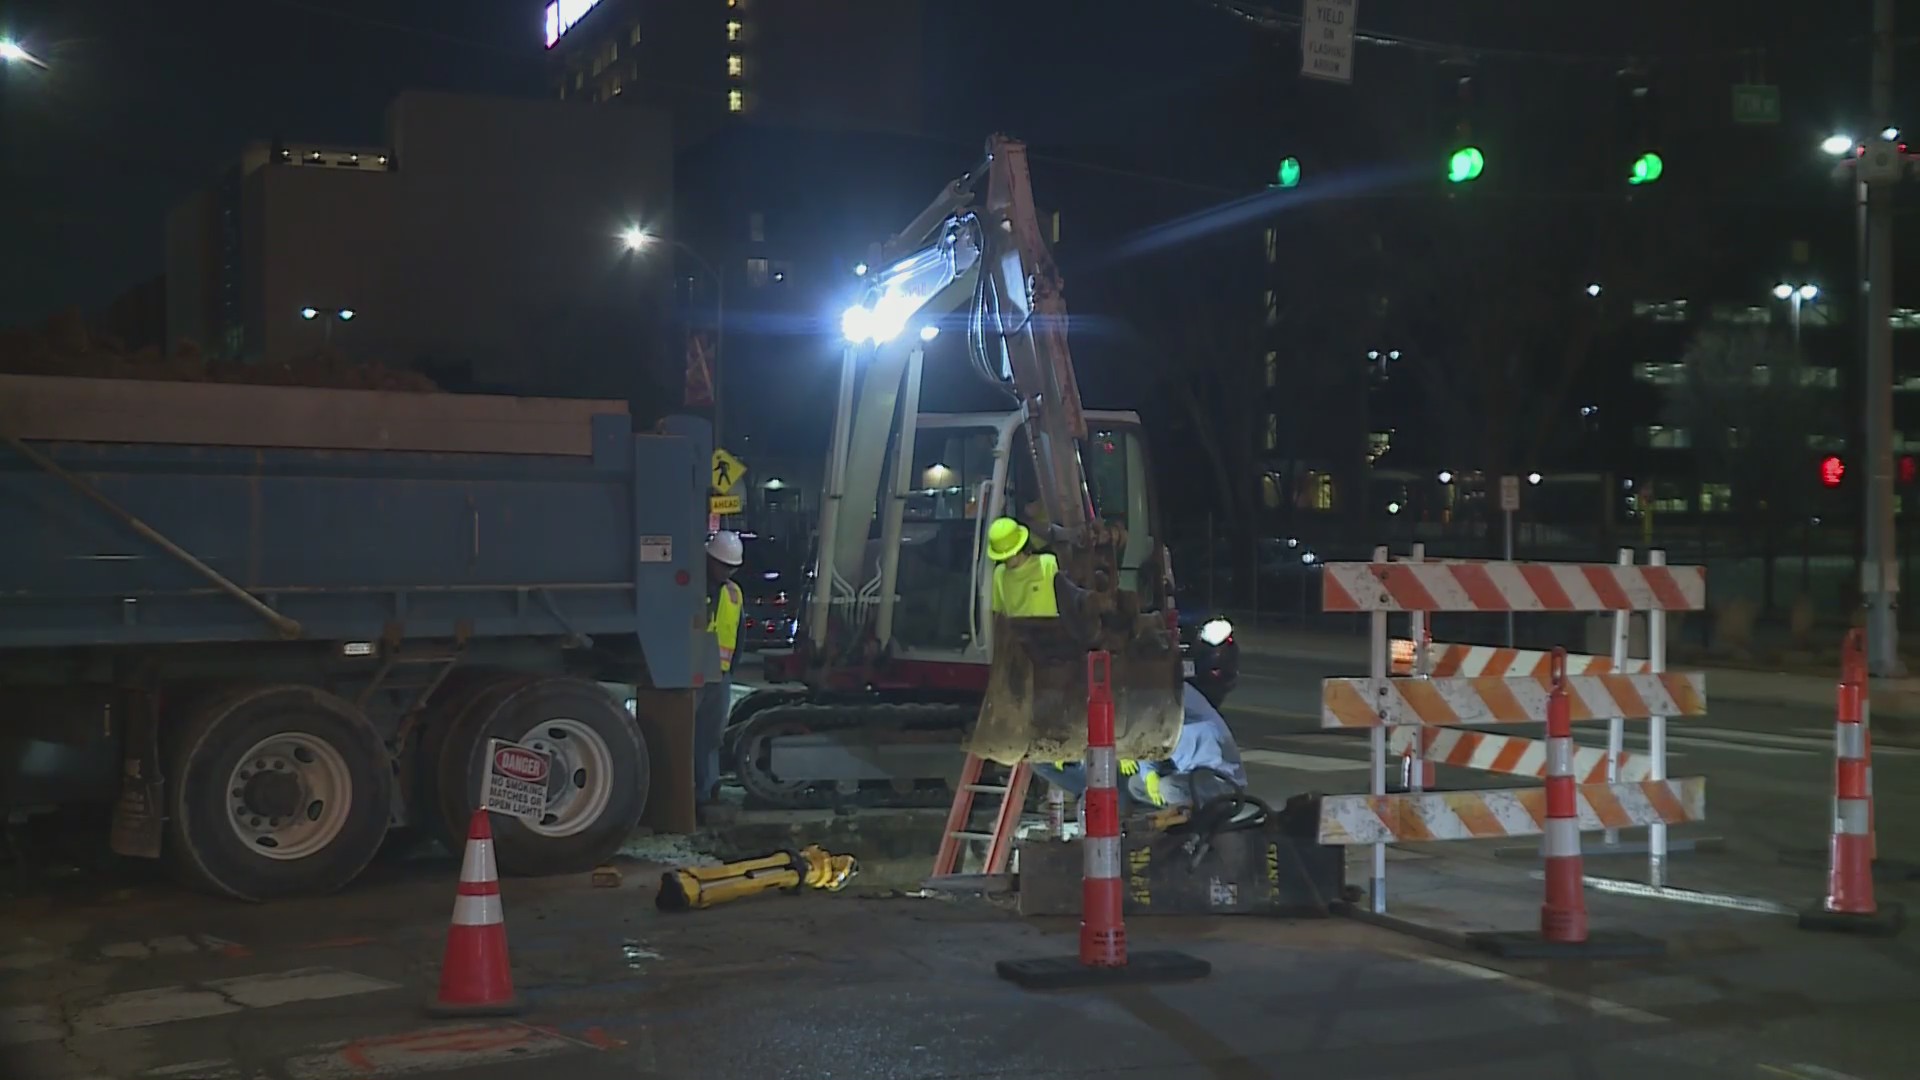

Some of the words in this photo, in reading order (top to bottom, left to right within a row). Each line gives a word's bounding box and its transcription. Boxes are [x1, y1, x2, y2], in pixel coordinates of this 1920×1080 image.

[1317, 6, 1344, 24] YIELD
[1324, 27, 1335, 40] ON
[1309, 41, 1346, 58] FLASHING
[714, 499, 738, 508] AHEAD
[502, 752, 540, 776] DANGER
[491, 775, 503, 786] NO
[490, 787, 528, 803] MATCHES
[530, 796, 542, 806] OR
[489, 798, 511, 810] OPEN
[513, 804, 542, 818] LIGHTS
